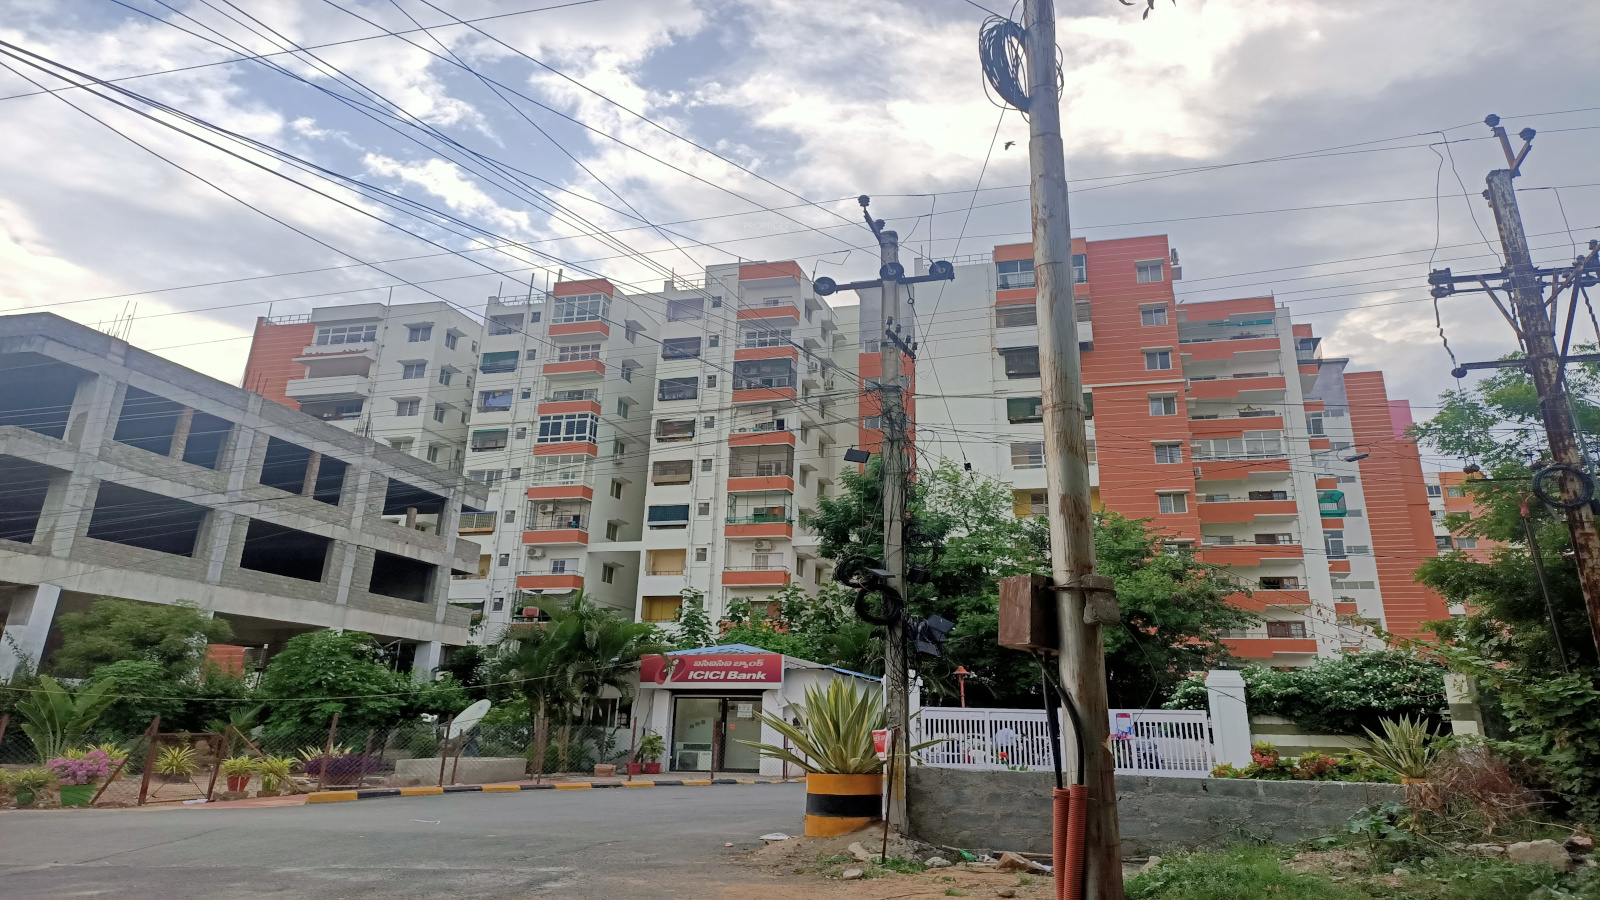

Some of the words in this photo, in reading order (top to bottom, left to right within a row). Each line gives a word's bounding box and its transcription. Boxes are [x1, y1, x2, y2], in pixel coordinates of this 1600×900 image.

[733, 658, 765, 668] బ్యాంక్
[688, 670, 724, 680] ICICI
[727, 670, 766, 680] Bank
